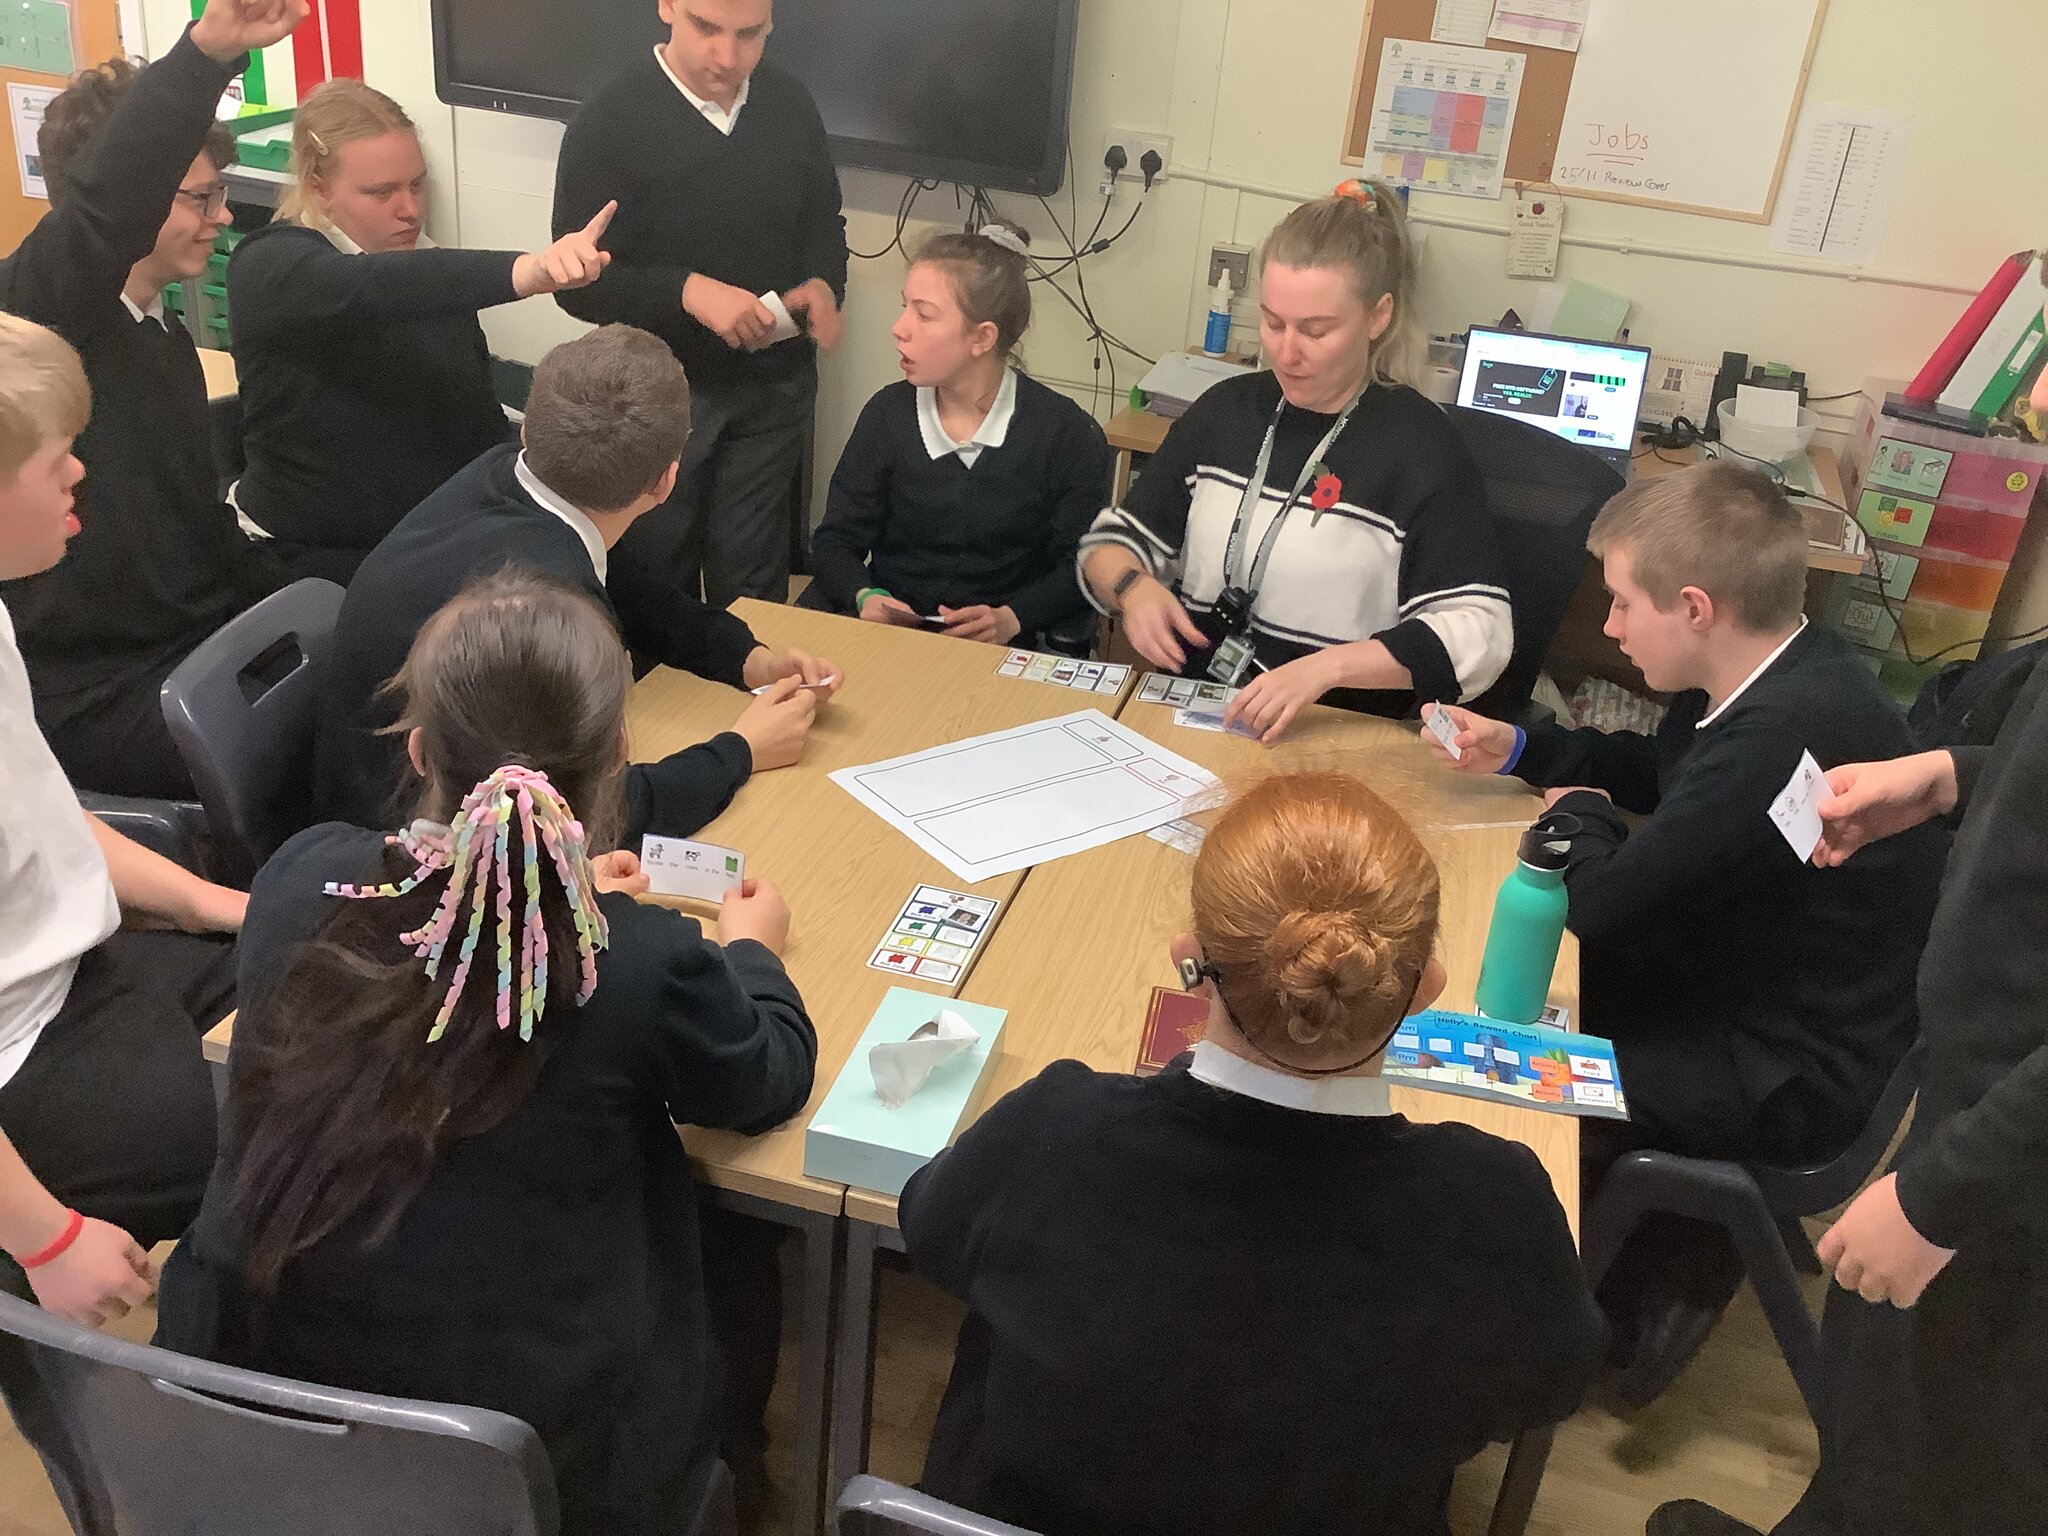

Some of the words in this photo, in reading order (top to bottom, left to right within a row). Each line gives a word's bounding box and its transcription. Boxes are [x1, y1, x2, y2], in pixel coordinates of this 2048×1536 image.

[1585, 123, 1649, 150] Jobs
[1560, 167, 1596, 184] 25/11
[1605, 171, 1642, 187] Review
[1473, 1022, 1508, 1034] Reward
[1512, 1030, 1538, 1041] Chart
